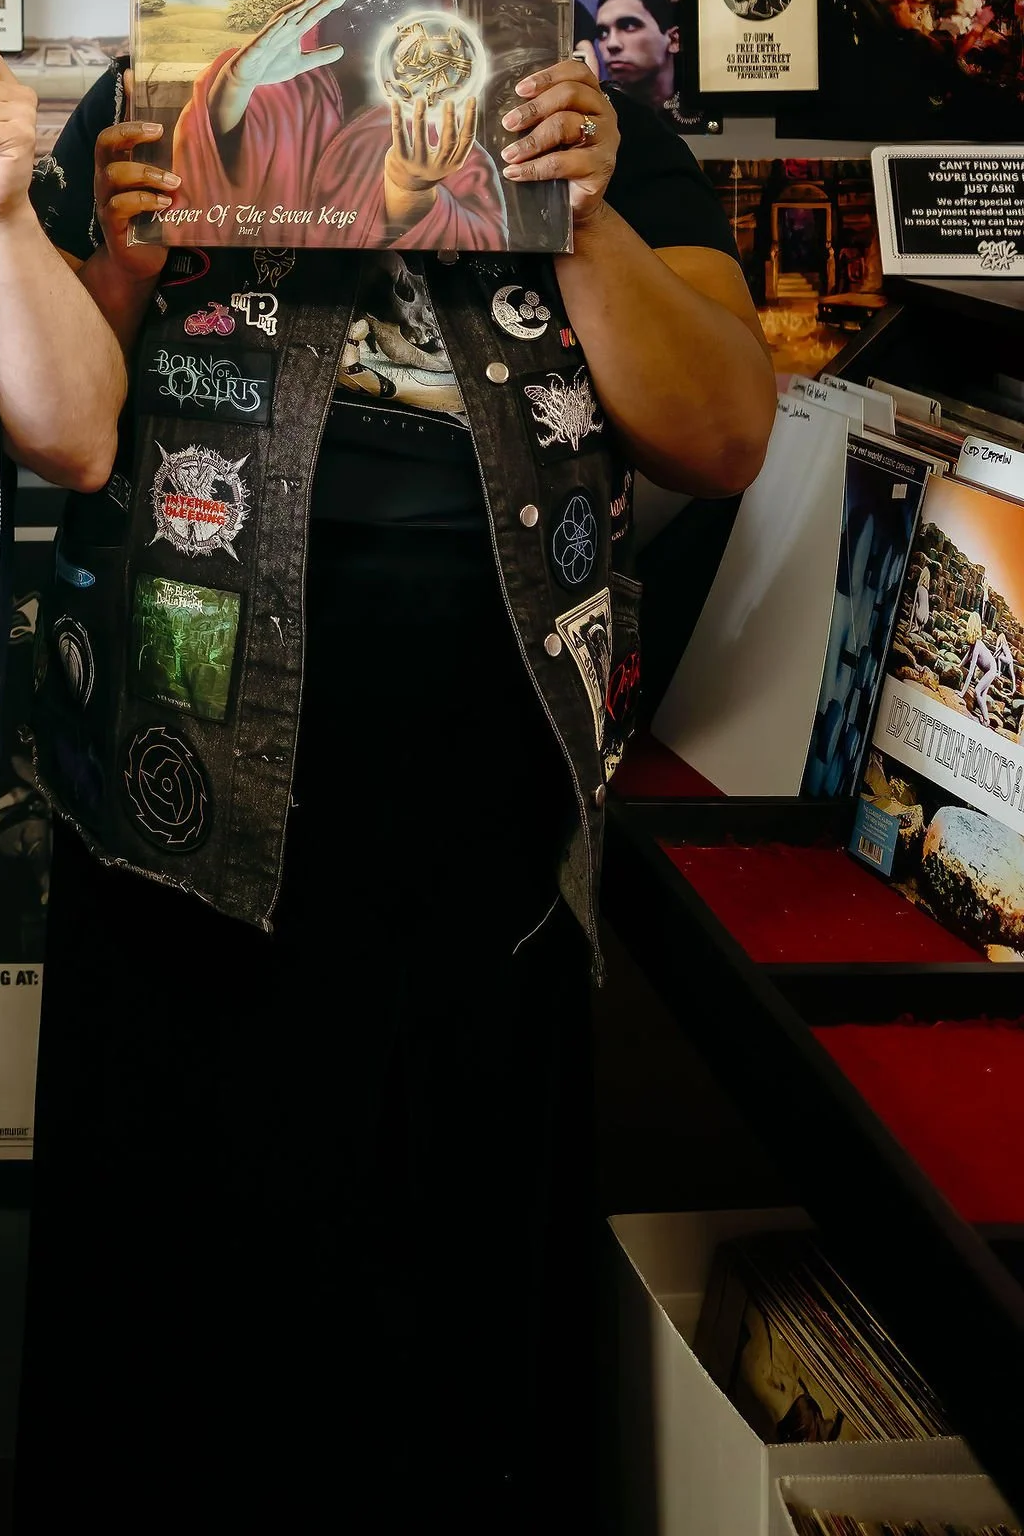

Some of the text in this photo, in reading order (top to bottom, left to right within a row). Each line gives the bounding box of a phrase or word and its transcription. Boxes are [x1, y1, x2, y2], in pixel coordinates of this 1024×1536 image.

[736, 43, 782, 53] FREE ENTRY
[737, 54, 760, 64] RIVER
[762, 53, 792, 64] STREET
[939, 161, 971, 171] CAN'T
[974, 161, 999, 171] FIND
[928, 172, 1019, 182] YOU'RE LOOKING
[964, 184, 1016, 195] JUST ASK!
[936, 197, 1012, 208] We offer special
[151, 205, 358, 229] Keeper Of The Seven Keys
[911, 208, 1004, 218] no payment needed
[904, 217, 914, 226] In
[916, 218, 940, 226] most
[941, 219, 970, 227] cases,
[238, 226, 254, 236] Part
[941, 228, 963, 237] here
[964, 228, 973, 236] in
[975, 228, 994, 238] just
[1004, 228, 1021, 236] few
[977, 240, 1018, 258] STATIC
[153, 350, 213, 375] BORN
[159, 367, 262, 413] OSIRIS
[929, 401, 937, 415] K
[15, 970, 39, 986] AT:
